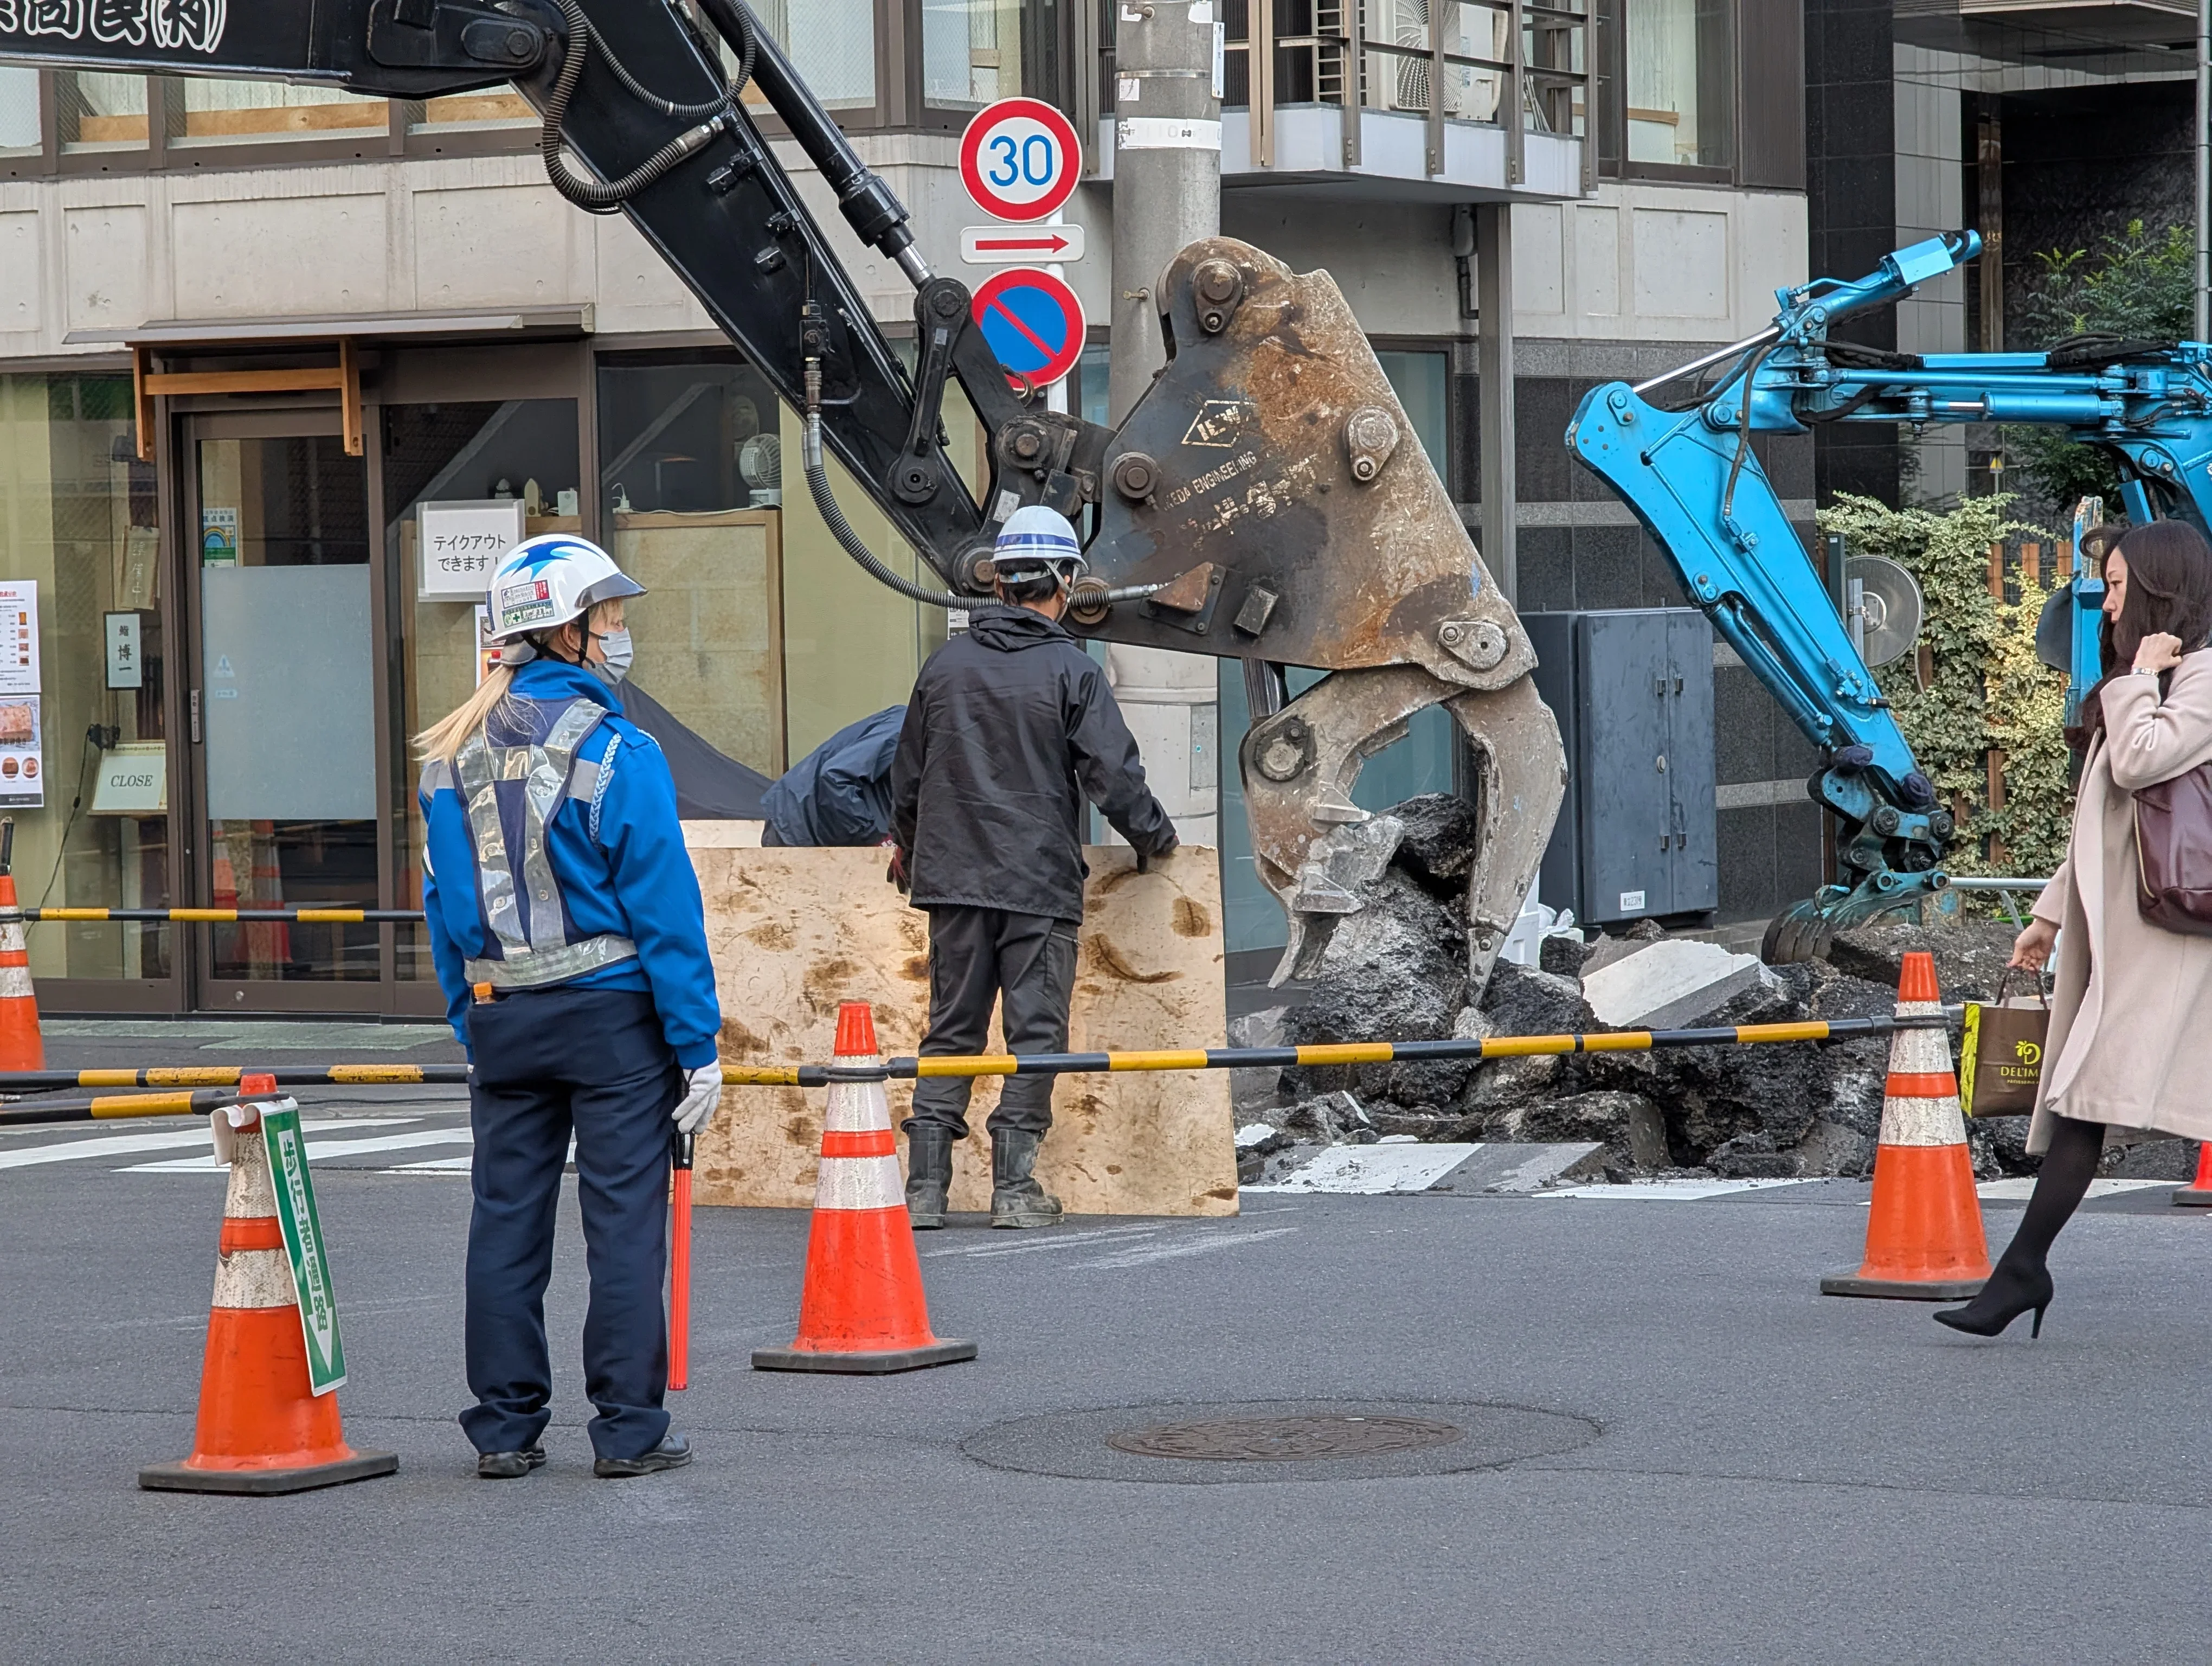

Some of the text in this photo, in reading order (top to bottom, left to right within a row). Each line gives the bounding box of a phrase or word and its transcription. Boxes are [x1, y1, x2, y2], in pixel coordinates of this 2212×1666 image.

[989, 134, 1053, 187] 30
[434, 534, 506, 550] テイクアウト
[111, 775, 153, 787] CLOSE
[283, 1139, 329, 1332] 歩行者通路
